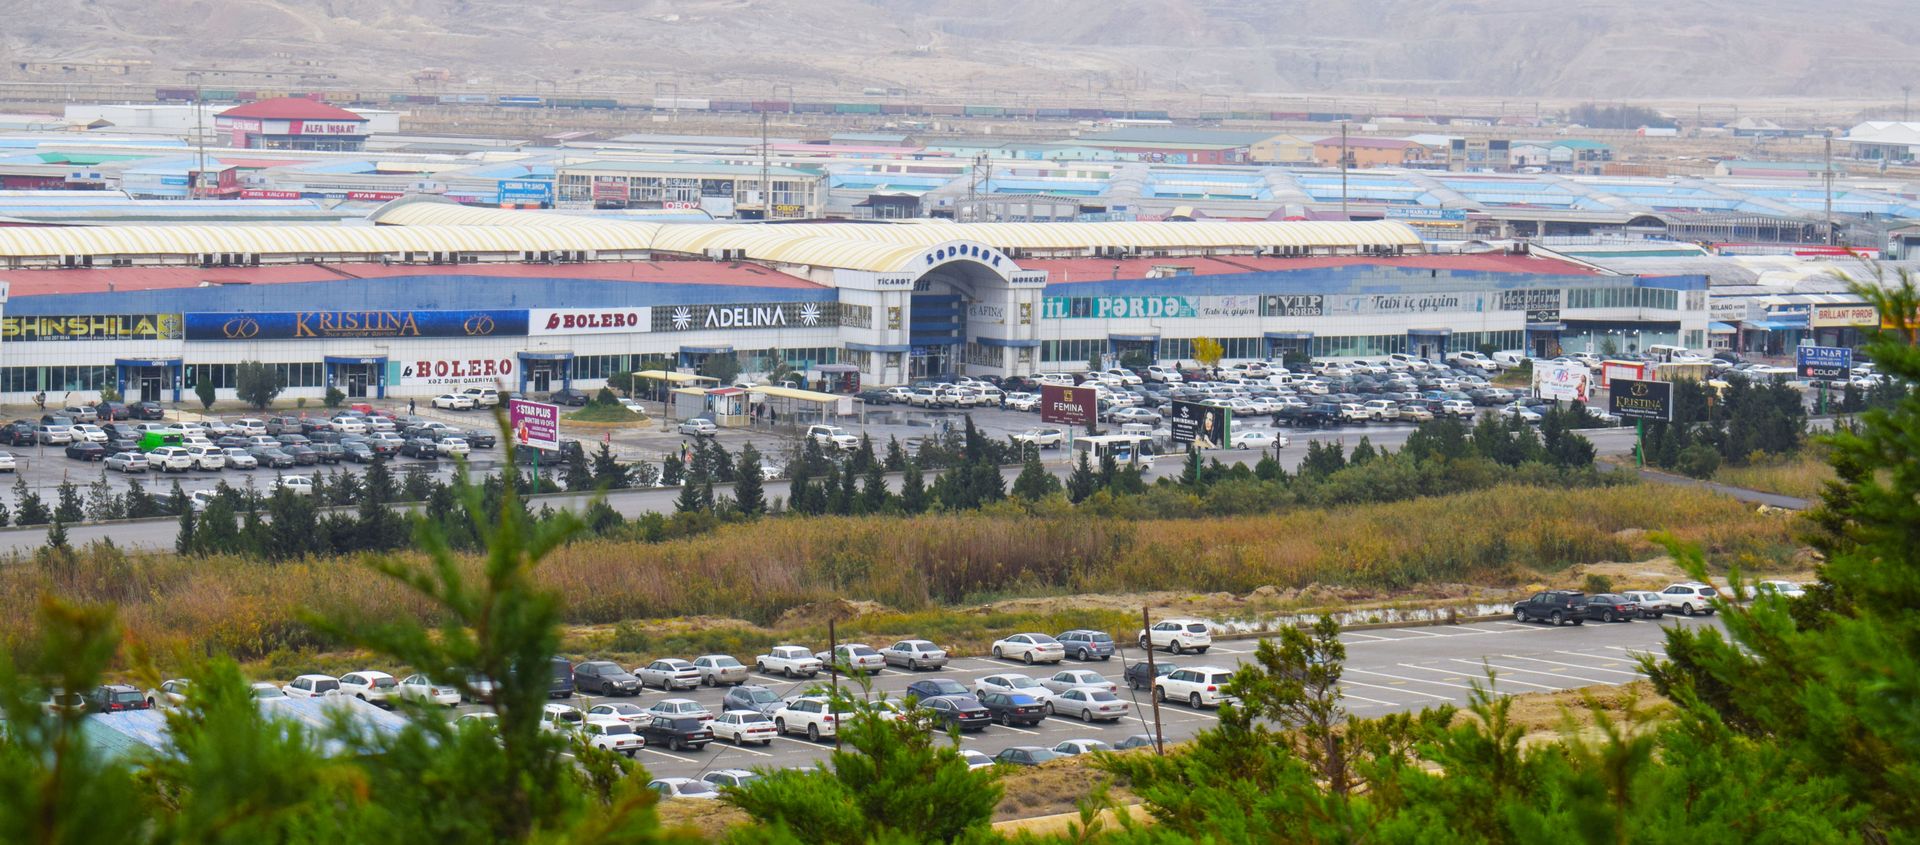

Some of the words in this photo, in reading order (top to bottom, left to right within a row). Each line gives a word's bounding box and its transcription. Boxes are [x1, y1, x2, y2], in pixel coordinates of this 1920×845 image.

[304, 124, 324, 133] ALFA
[294, 311, 421, 337] KRISTINA
[563, 313, 638, 328] BOLERO
[705, 305, 786, 328] ADELINA
[3, 317, 157, 336] SHINSHILA
[416, 359, 512, 378] BOLERO
[1054, 402, 1084, 413] FEMINA
[1616, 396, 1661, 408] KRISTINA
[520, 405, 536, 415] STAR
[536, 407, 551, 418] PLUS
